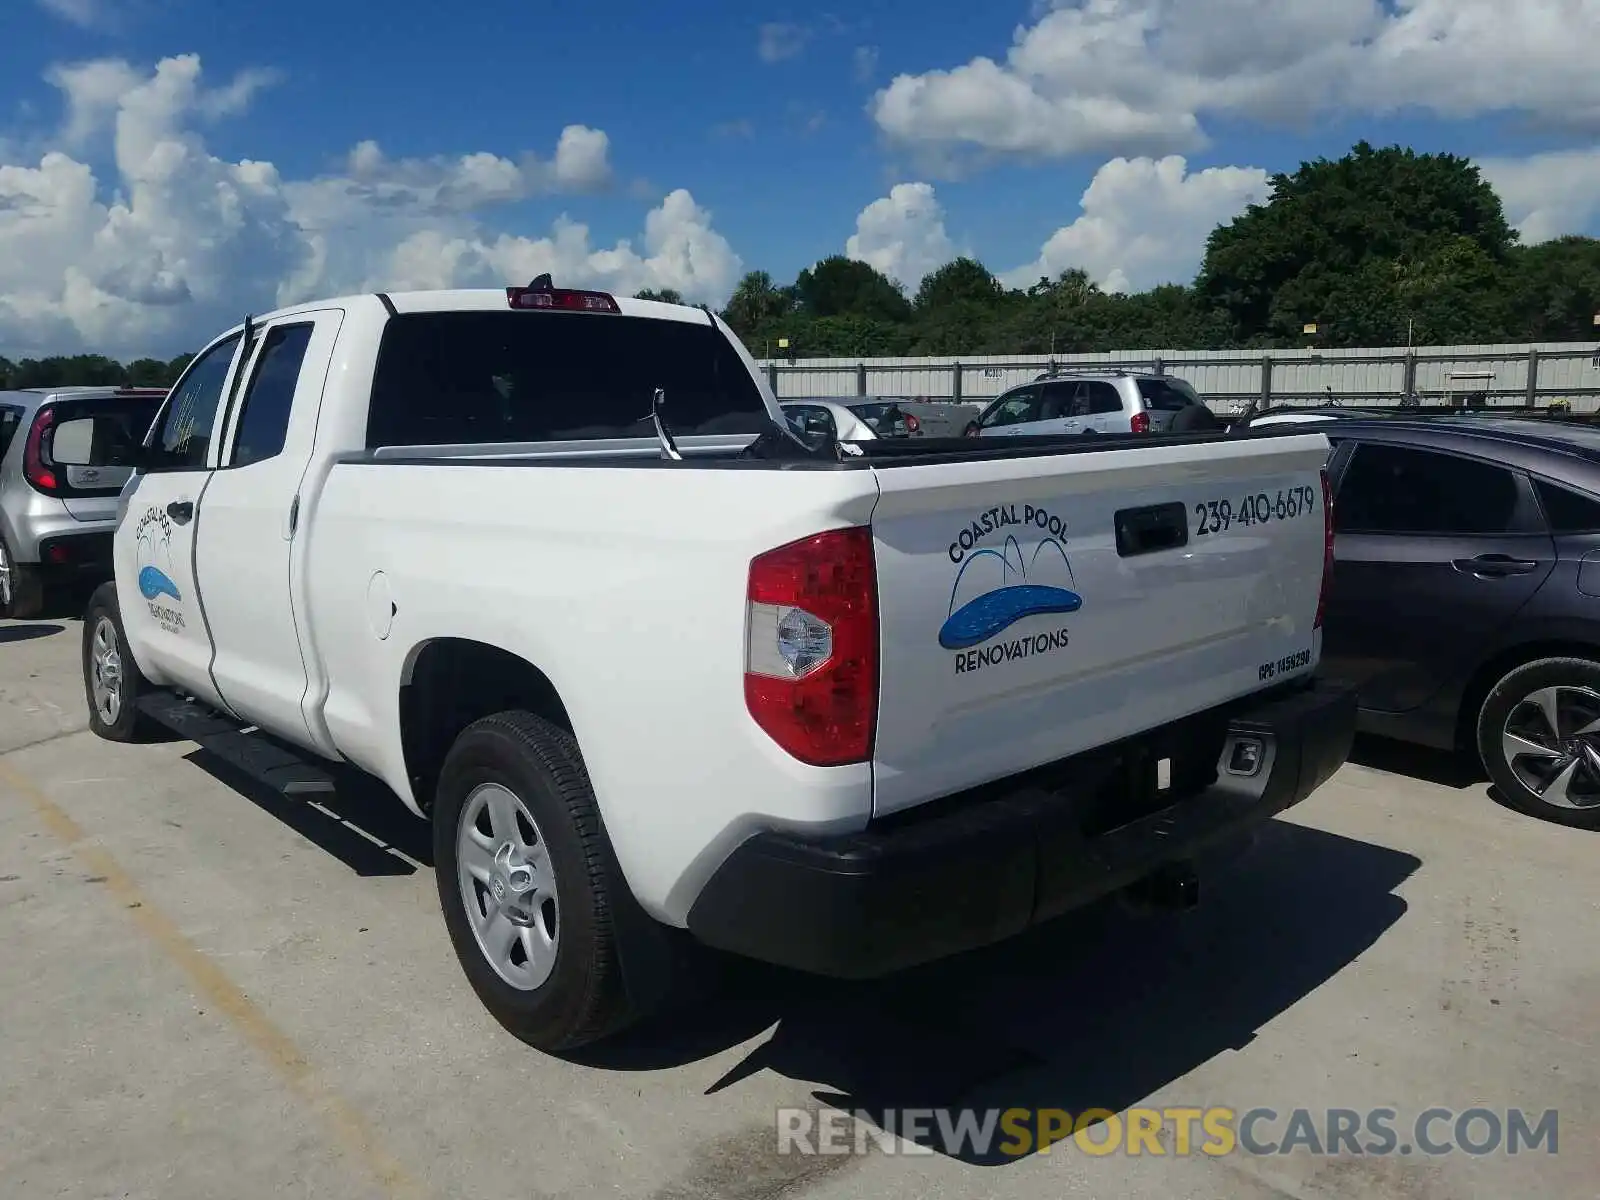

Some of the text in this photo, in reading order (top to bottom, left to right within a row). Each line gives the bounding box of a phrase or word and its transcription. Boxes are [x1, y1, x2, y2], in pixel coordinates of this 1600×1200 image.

[949, 504, 1069, 564] COASTAL POOL
[1195, 485, 1314, 536] 239-410-6679
[955, 628, 1069, 674] RENOVATIONS
